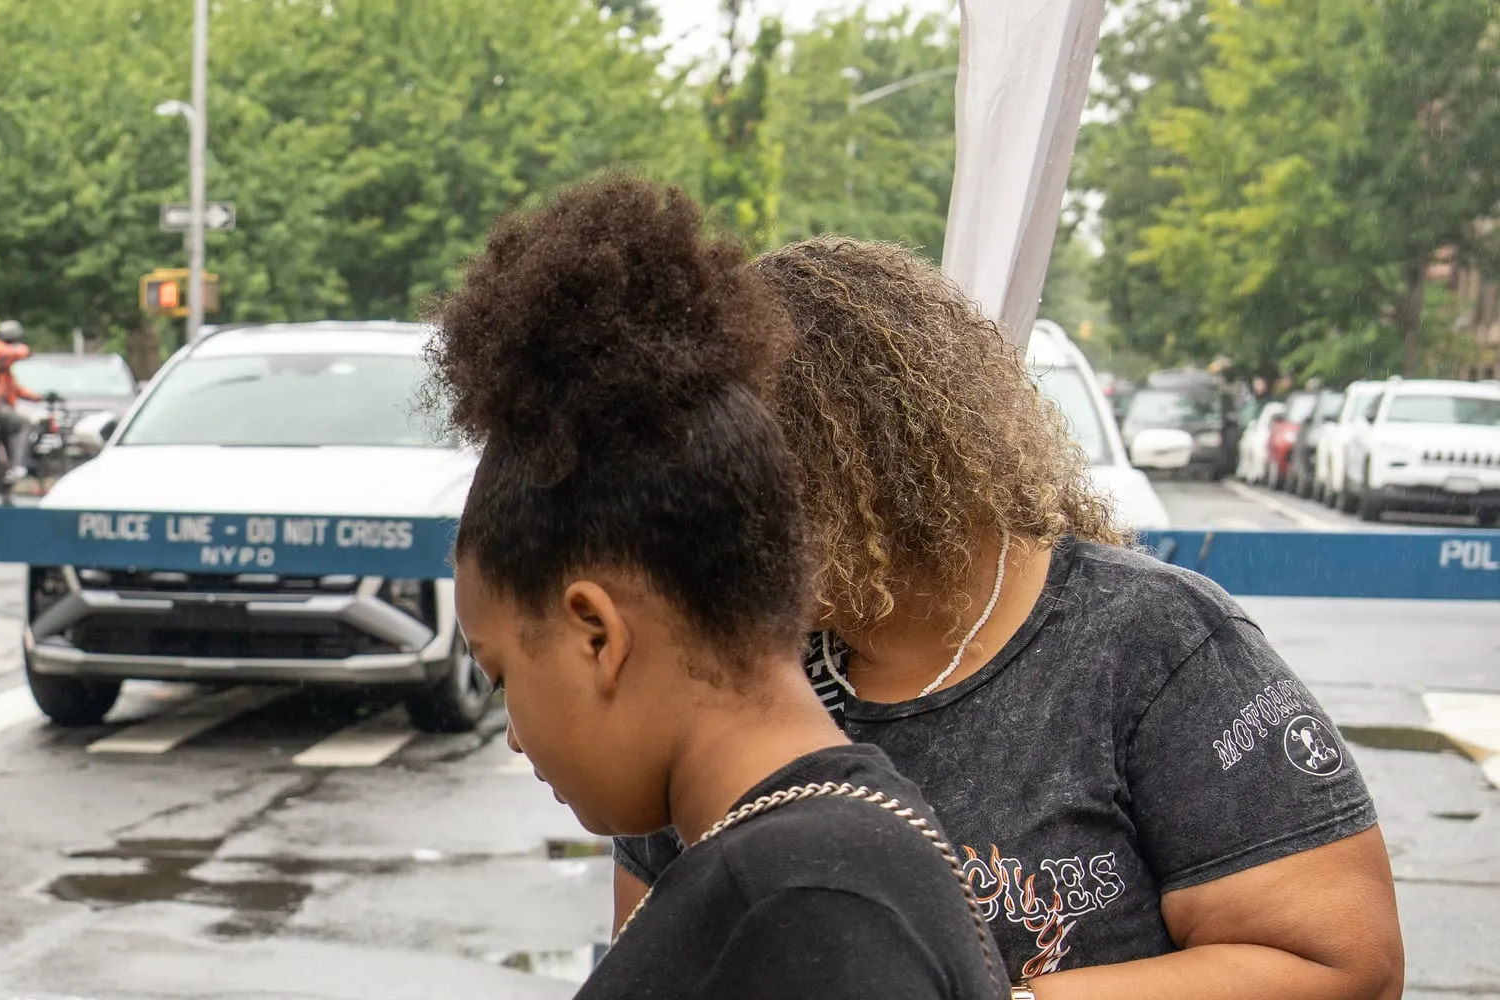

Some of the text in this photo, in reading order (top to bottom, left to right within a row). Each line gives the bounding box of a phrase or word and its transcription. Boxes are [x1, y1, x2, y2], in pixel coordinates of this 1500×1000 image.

[78, 512, 150, 540] POLICE
[165, 515, 214, 543] LINE
[246, 517, 276, 544] DO
[283, 518, 329, 546] NOT
[336, 520, 413, 548] CROSS
[200, 547, 275, 567] NYPD
